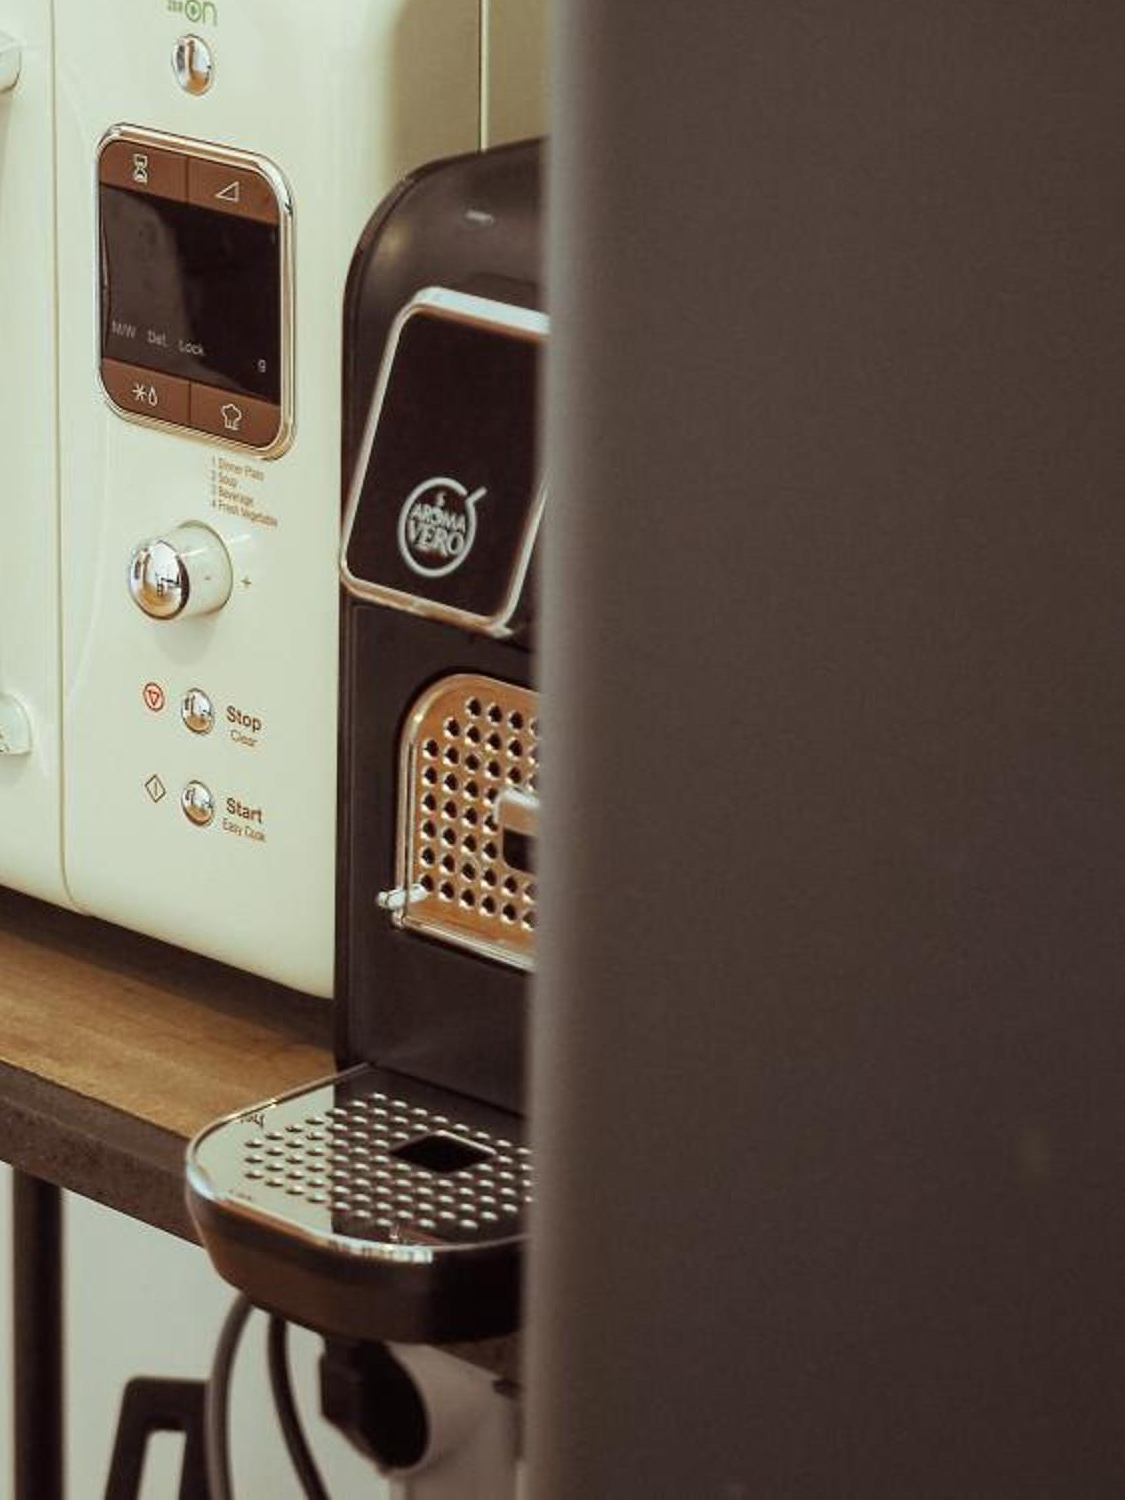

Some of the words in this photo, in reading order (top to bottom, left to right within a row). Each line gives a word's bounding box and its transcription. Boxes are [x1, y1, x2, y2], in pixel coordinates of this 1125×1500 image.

[178, 339, 205, 357] Lock
[410, 502, 466, 533] AROMA
[409, 519, 464, 557] VERO
[226, 705, 262, 733] Stop
[226, 797, 263, 824] Start
